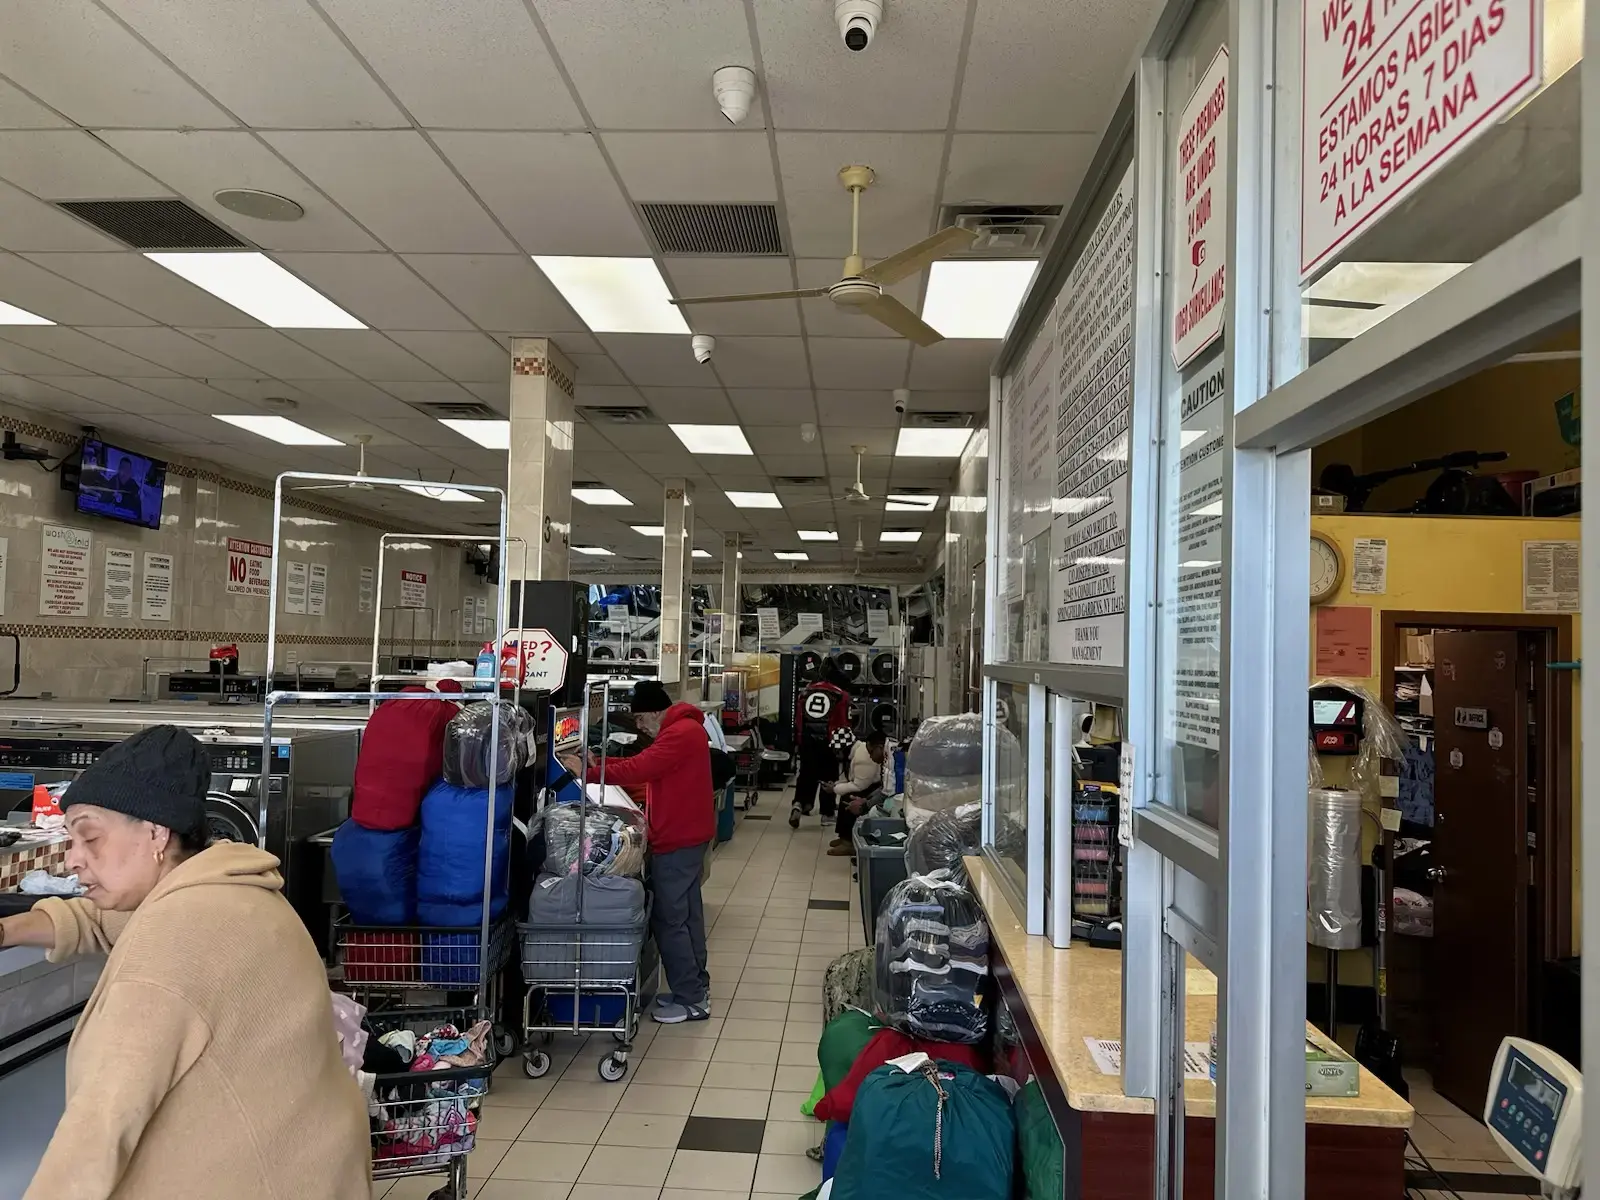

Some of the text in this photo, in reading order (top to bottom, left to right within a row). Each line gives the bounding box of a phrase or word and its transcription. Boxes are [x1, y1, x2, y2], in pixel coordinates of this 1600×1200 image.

[1342, 0, 1375, 80] 24
[1319, 50, 1398, 164] ESTAMOS
[1320, 0, 1505, 203] 24 HORAS 7 DIAS
[1180, 76, 1224, 173] THESE PREMISES
[1334, 71, 1478, 226] A LA SEMANA
[1181, 368, 1224, 419] CAUTION
[46, 530, 66, 539] wash
[544, 515, 551, 544] 3
[229, 540, 272, 557] ATTENTION CUSTOMERS
[230, 556, 246, 583] NO
[249, 560, 262, 568] EATING
[249, 568, 260, 576] FOOD
[1327, 564, 1333, 572] 3
[249, 577, 270, 587] BEVERAGES
[405, 572, 423, 582] NOTICE
[228, 585, 245, 593] ALLOWED
[253, 587, 270, 596] PREMISES
[1074, 625, 1099, 640] THANK YOU
[1071, 646, 1101, 660] MANAGEMENT
